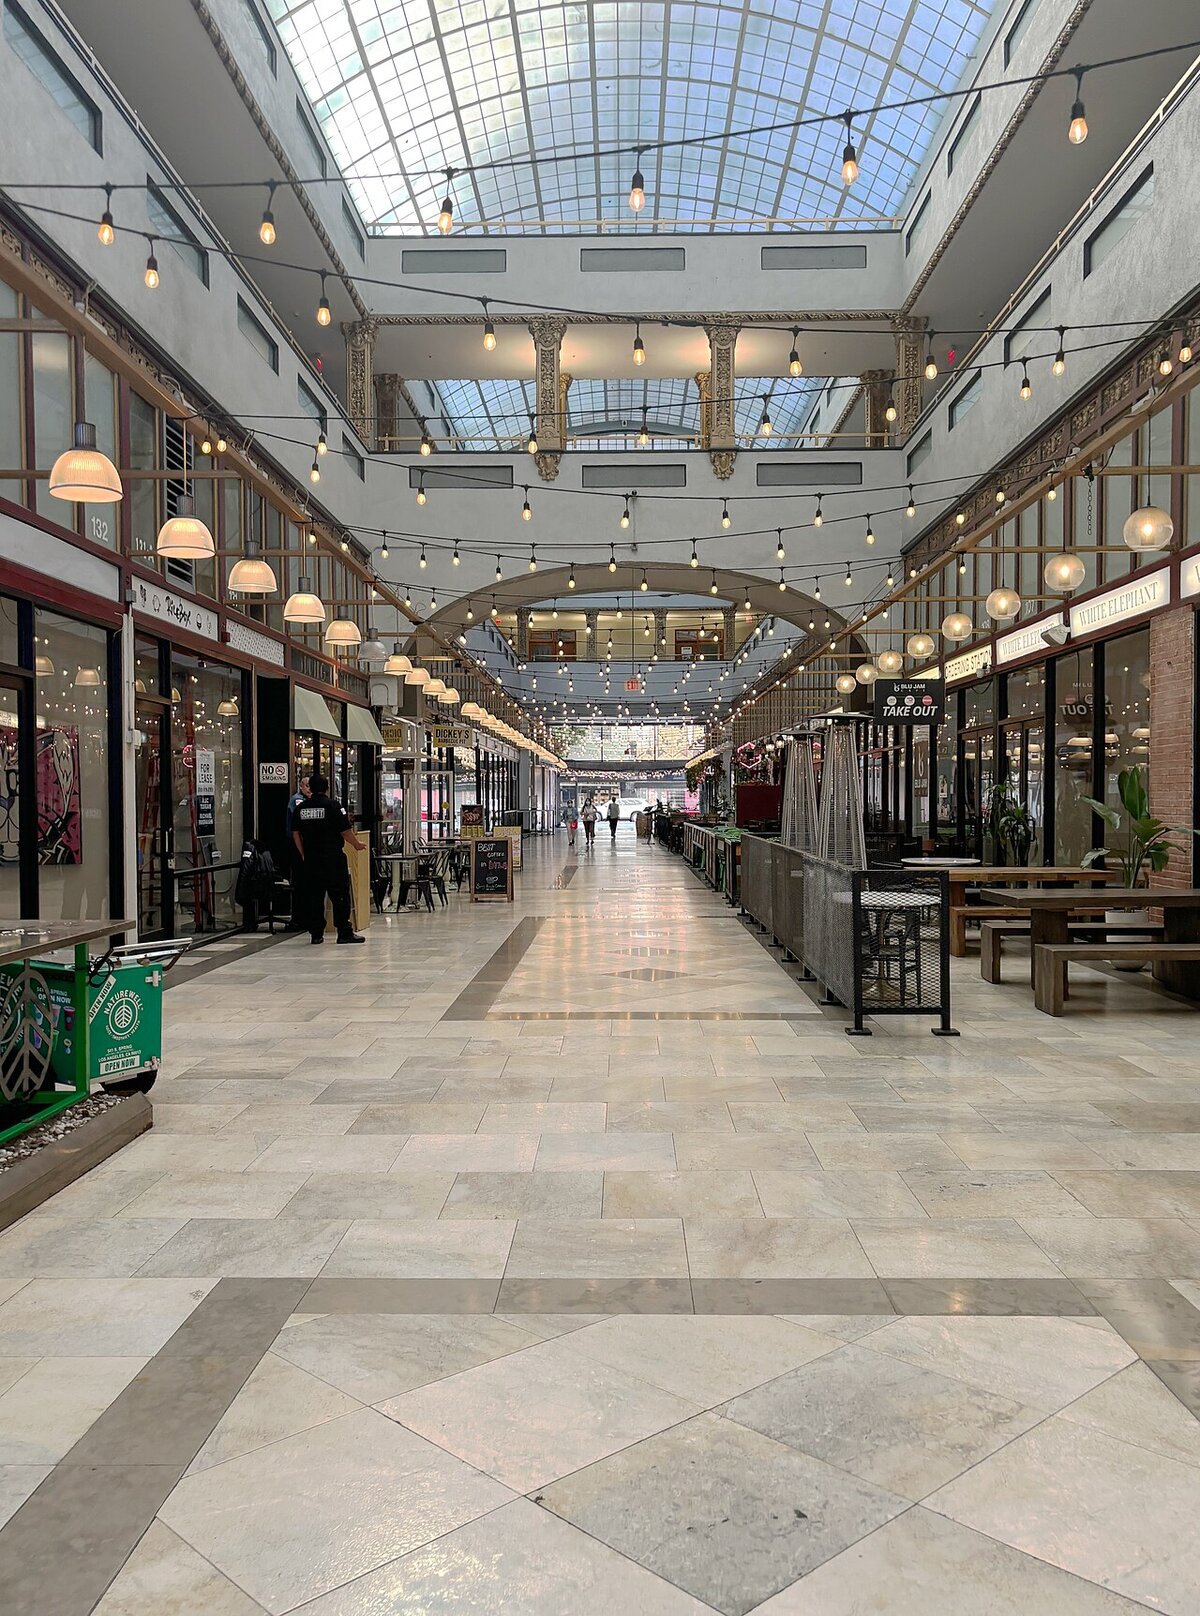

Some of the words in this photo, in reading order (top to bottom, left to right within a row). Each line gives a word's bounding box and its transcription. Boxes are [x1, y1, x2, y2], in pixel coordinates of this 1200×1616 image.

[90, 516, 109, 542] 132
[1079, 603, 1107, 627] WHITE
[1108, 581, 1158, 617] ELEPHANT
[1002, 635, 1021, 657] WHITE
[944, 657, 969, 680] ORDERING
[882, 706, 911, 717] TAKE
[913, 706, 938, 717] OUT
[435, 728, 470, 739] DICKEY'S
[200, 763, 210, 773] FOR
[261, 765, 274, 775] NO
[199, 773, 213, 784] LEASE
[301, 808, 325, 819] SECURITY
[477, 843, 496, 852] BEST
[38, 993, 55, 1003] OPN
[56, 995, 72, 1004] NOW
[89, 996, 103, 1018] OPEN
[101, 981, 112, 998] NOW
[103, 989, 142, 1015] NATUREWELL
[104, 1061, 120, 1072] OPEN
[121, 1057, 135, 1068] NOW
